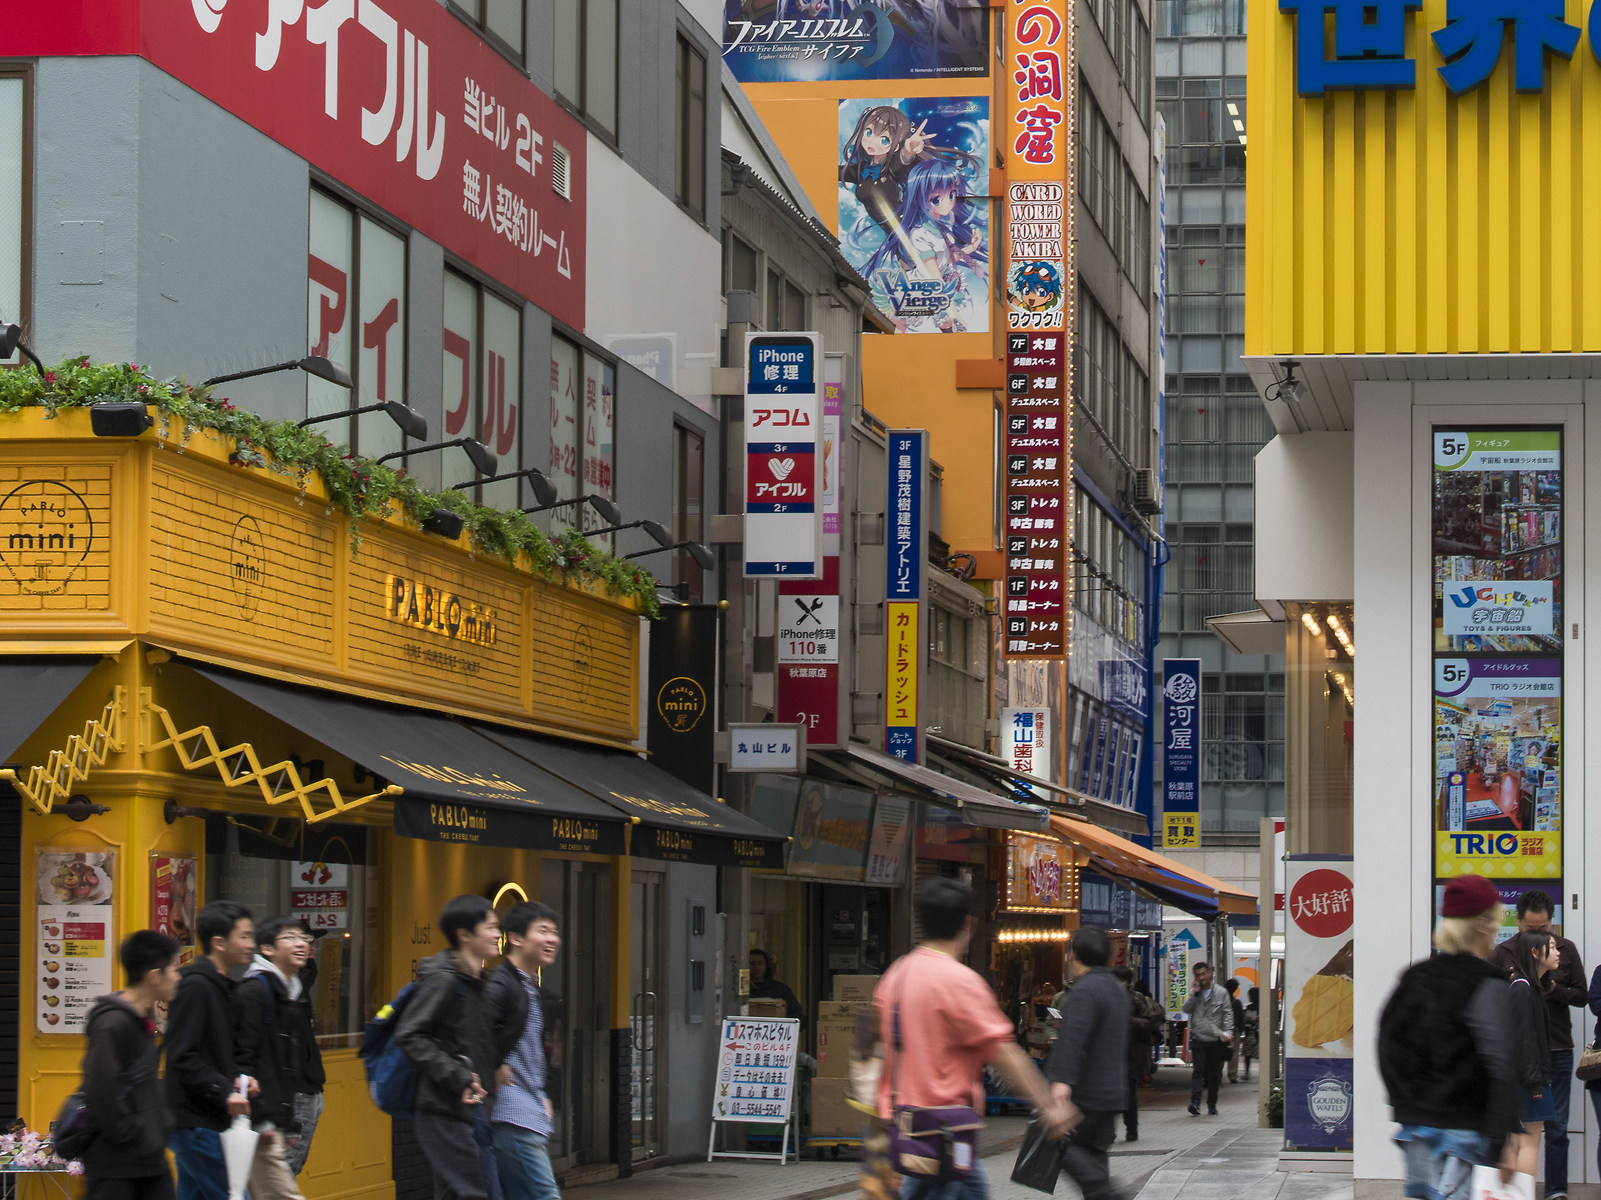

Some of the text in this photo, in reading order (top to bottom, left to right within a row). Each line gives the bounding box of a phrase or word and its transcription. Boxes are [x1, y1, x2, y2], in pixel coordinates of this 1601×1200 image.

[739, 44, 800, 53] TCG Fire Emblem
[801, 43, 865, 61] サイファ
[463, 76, 543, 177] 当ビル 2F
[1010, 183, 1063, 202] CARD
[1010, 203, 1063, 221] WORLD
[462, 159, 572, 280] 無人契約ルーム
[1010, 222, 1062, 241] TOWER
[1011, 241, 1063, 258] AKIBA
[1009, 312, 1063, 328] ワクワク!!
[1011, 337, 1057, 351] 7F 大型
[758, 349, 805, 365] iPhone
[763, 364, 800, 382] 修理
[774, 384, 788, 393] 4F
[1011, 376, 1058, 390] 6F 大型
[825, 385, 839, 399] 取
[752, 408, 811, 428] アコム
[1011, 417, 1058, 430] 5F 大型
[774, 444, 788, 453] 3F
[899, 440, 912, 450] 3F
[1442, 438, 1466, 456] 5F
[1475, 439, 1511, 447] フィギュア
[1010, 457, 1058, 470] 4F 大型
[755, 482, 807, 498] アイフル
[21, 501, 67, 518] PABLO
[774, 503, 788, 512] 2F
[1010, 497, 1059, 511] 3F トレカ
[897, 455, 912, 594] 星野茂樹建築アトリエ
[1009, 517, 1034, 529] 中古
[9, 523, 75, 549] mini
[1010, 538, 1059, 551] 2F トレカ
[774, 563, 788, 572] 1F
[1009, 558, 1034, 570] 中古
[1010, 579, 1059, 591] 1F トレカ
[392, 576, 463, 638] PABLO
[1472, 607, 1524, 625] 宇宙船
[1010, 620, 1059, 632] B1 トレカ
[780, 628, 837, 640] iPhone修理
[789, 641, 828, 656] 110番
[789, 668, 827, 679] 秋葉原店
[896, 612, 911, 721] カードラッシュ
[1442, 665, 1467, 682] 5F
[1483, 663, 1530, 672] アイドルグッズ
[669, 687, 695, 697] PABLO
[1490, 683, 1509, 691] TRIO
[664, 698, 699, 712] mini
[796, 711, 820, 730] 2F
[738, 742, 791, 754] 丸山ビル
[895, 749, 908, 759] 3F
[1168, 781, 1194, 791] 秋葉原
[430, 803, 487, 831] PABLO mini
[552, 818, 599, 842] PABLO mini
[1167, 825, 1195, 838] 買取
[1167, 837, 1195, 846] センター
[1450, 833, 1545, 855] TRIO ラジオ
[1520, 846, 1544, 857] 会館店
[410, 921, 432, 945] Just
[1316, 1104, 1344, 1112] WAFELS
